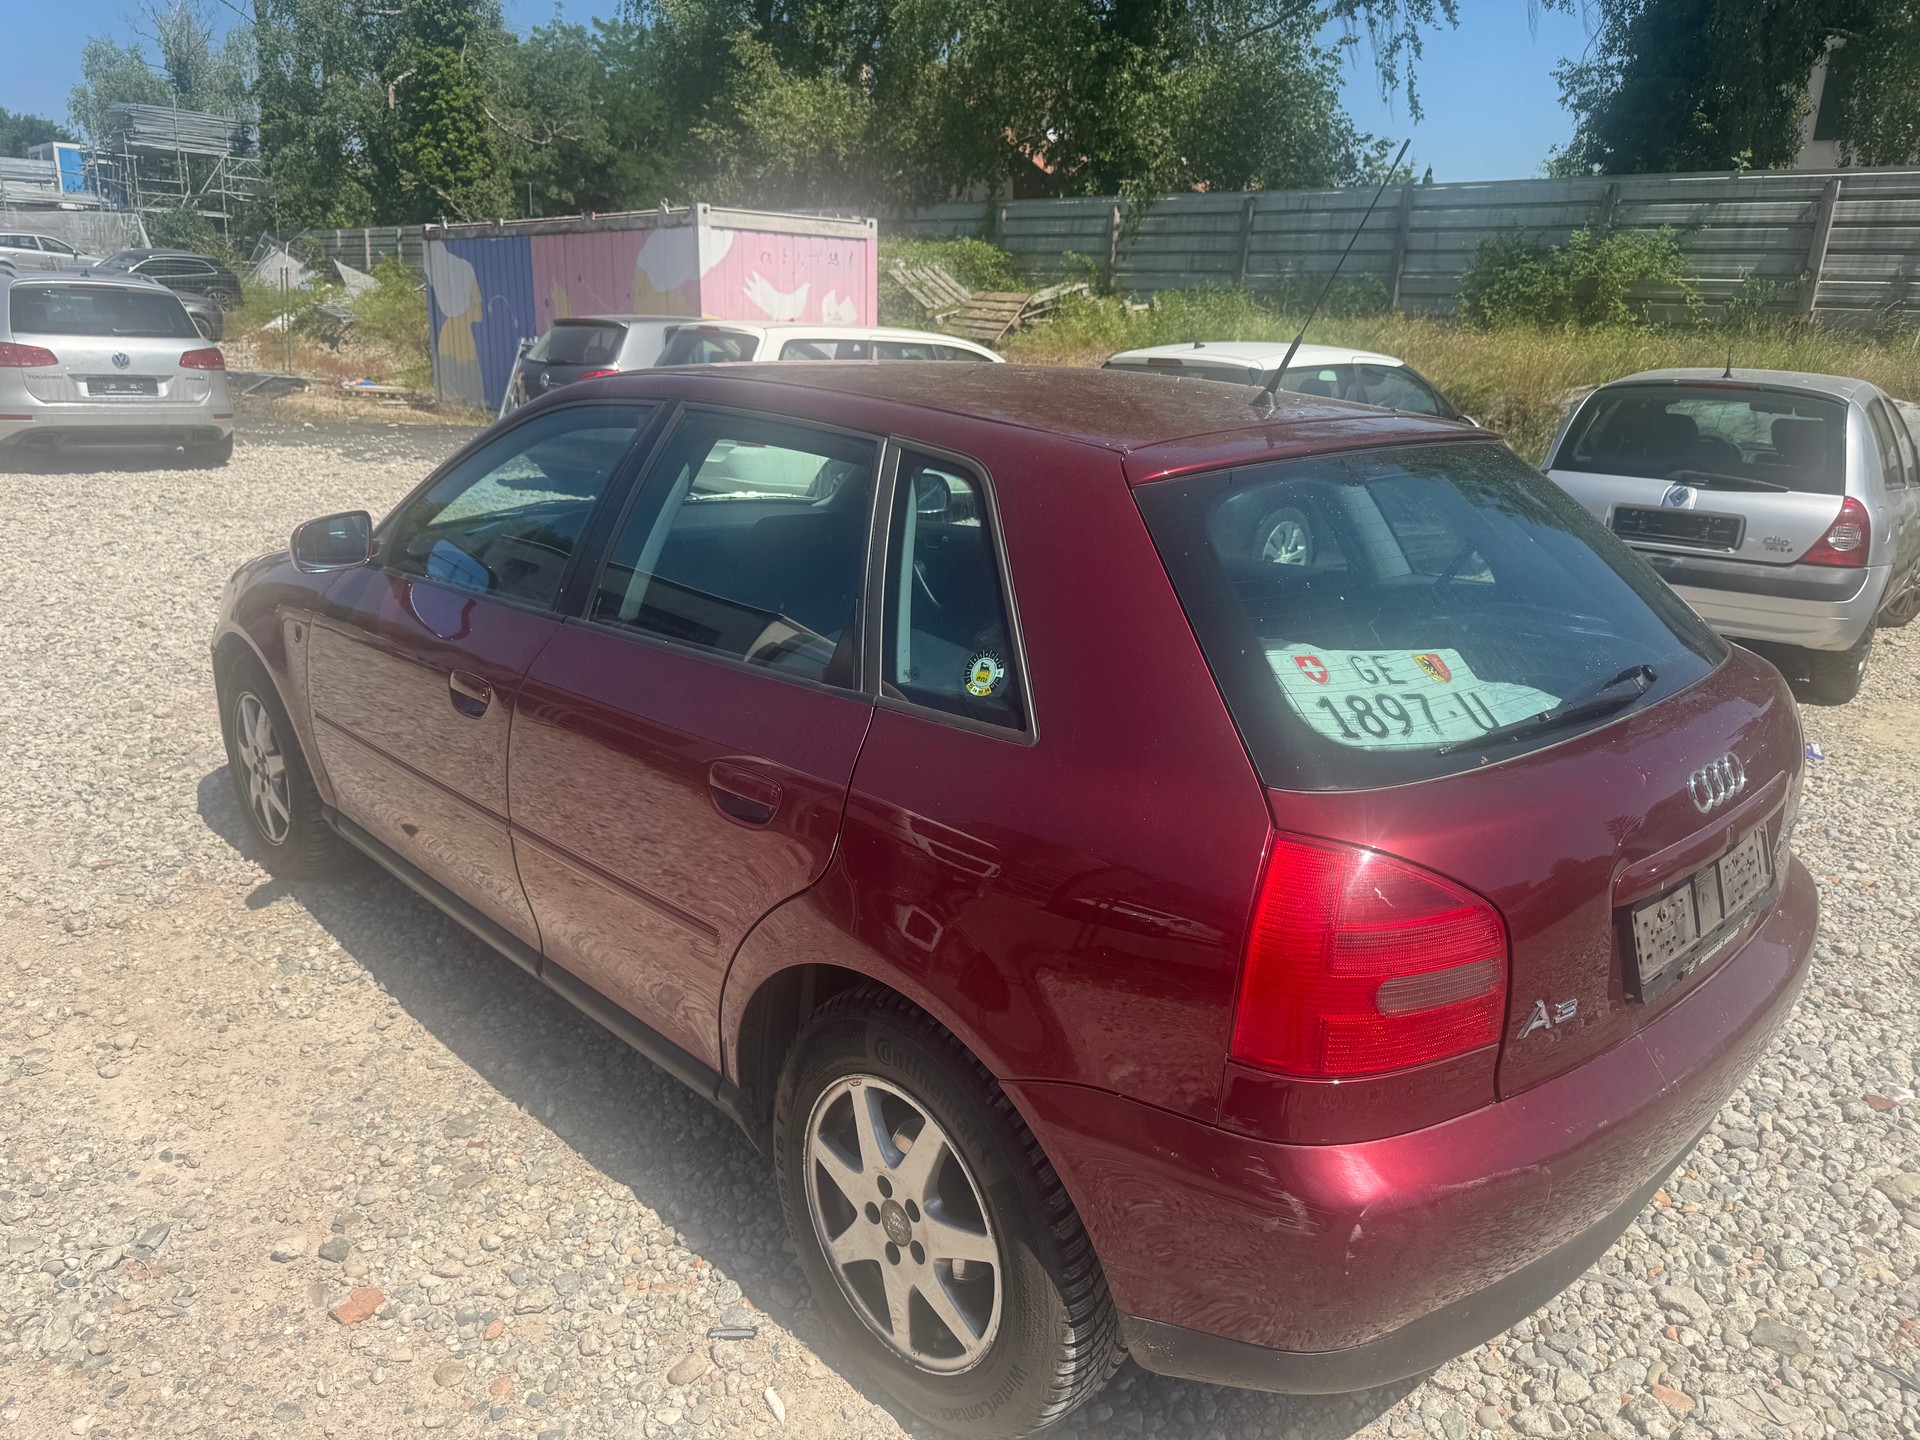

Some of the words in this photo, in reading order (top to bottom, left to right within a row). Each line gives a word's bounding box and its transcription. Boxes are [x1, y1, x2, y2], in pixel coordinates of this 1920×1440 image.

[1348, 655, 1408, 685] GE
[1516, 998, 1578, 1040] A3
[873, 1037, 979, 1147] Continental
[938, 1363, 1030, 1424] WinterContact
